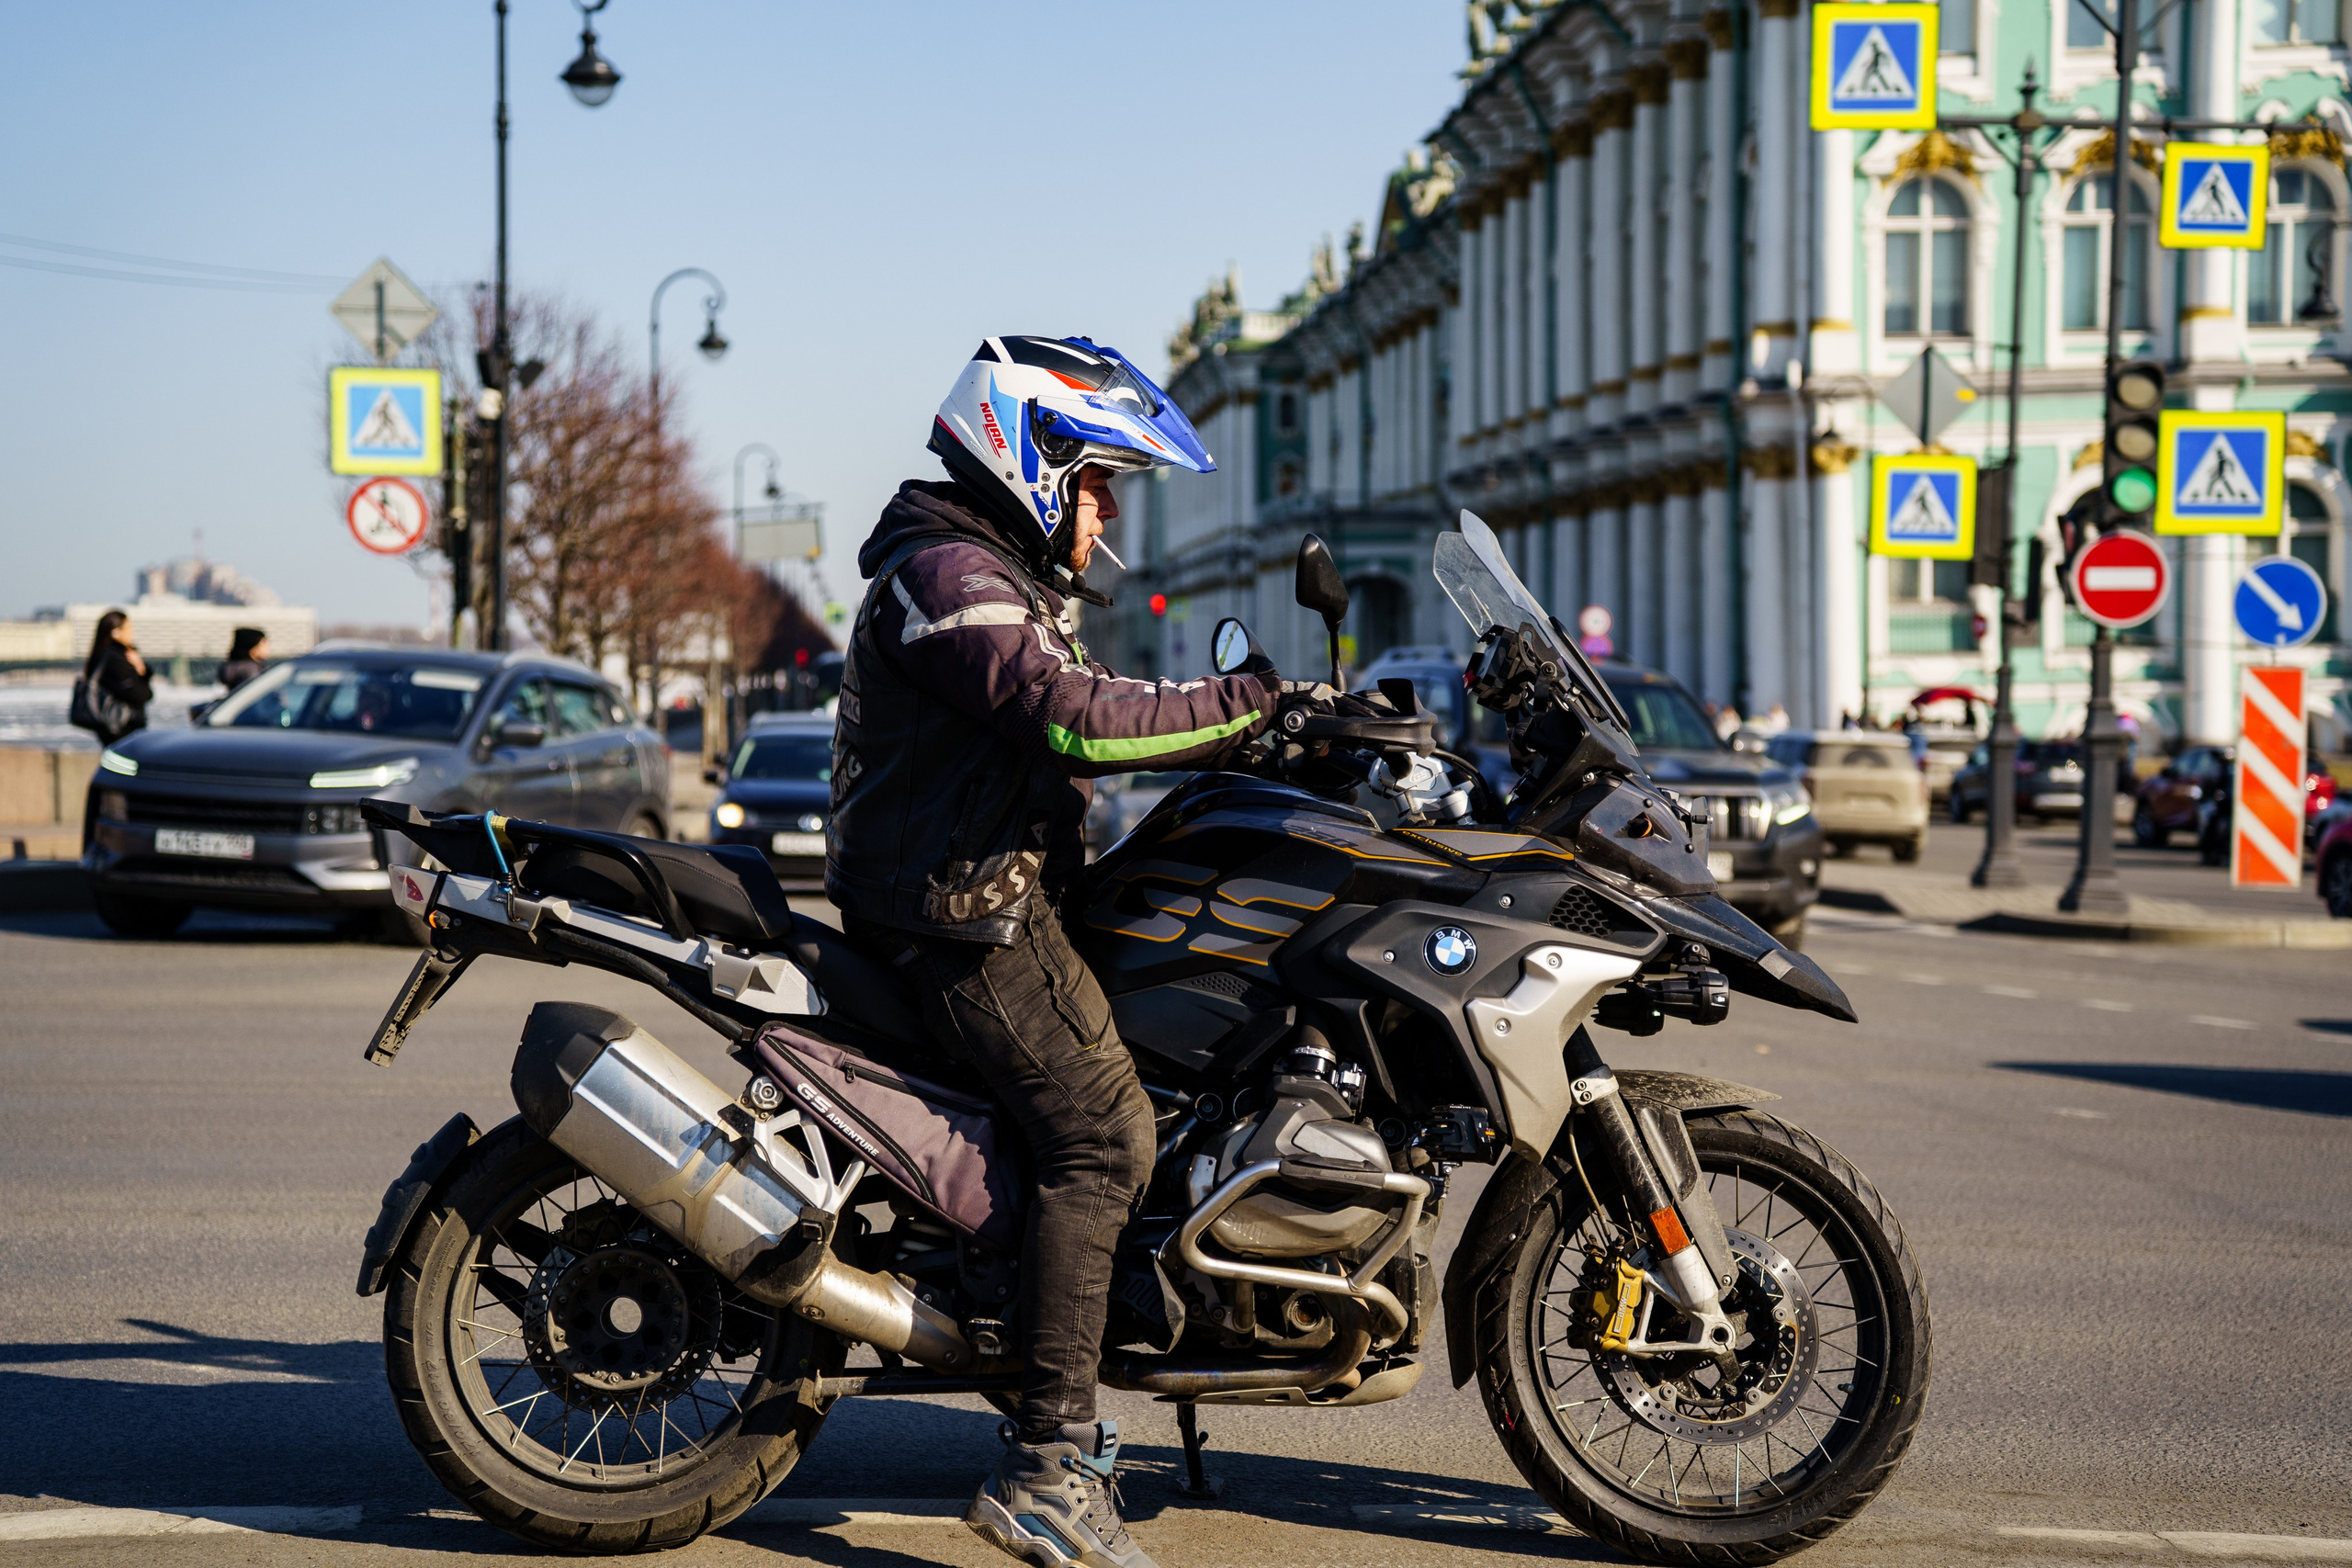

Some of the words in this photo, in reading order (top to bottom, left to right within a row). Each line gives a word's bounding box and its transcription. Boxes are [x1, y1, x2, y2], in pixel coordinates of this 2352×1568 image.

[979, 401, 1008, 450] NOLAN
[1412, 770, 1429, 783] GS
[1402, 830, 1463, 857] exclusive
[922, 820, 1048, 920] RUSSIA
[1435, 929, 1476, 950] BMW
[797, 1082, 833, 1114] GS
[827, 1112, 879, 1157] ADVENTURE
[1221, 1211, 1264, 1244] BMW
[1617, 1295, 1628, 1318] BMW
